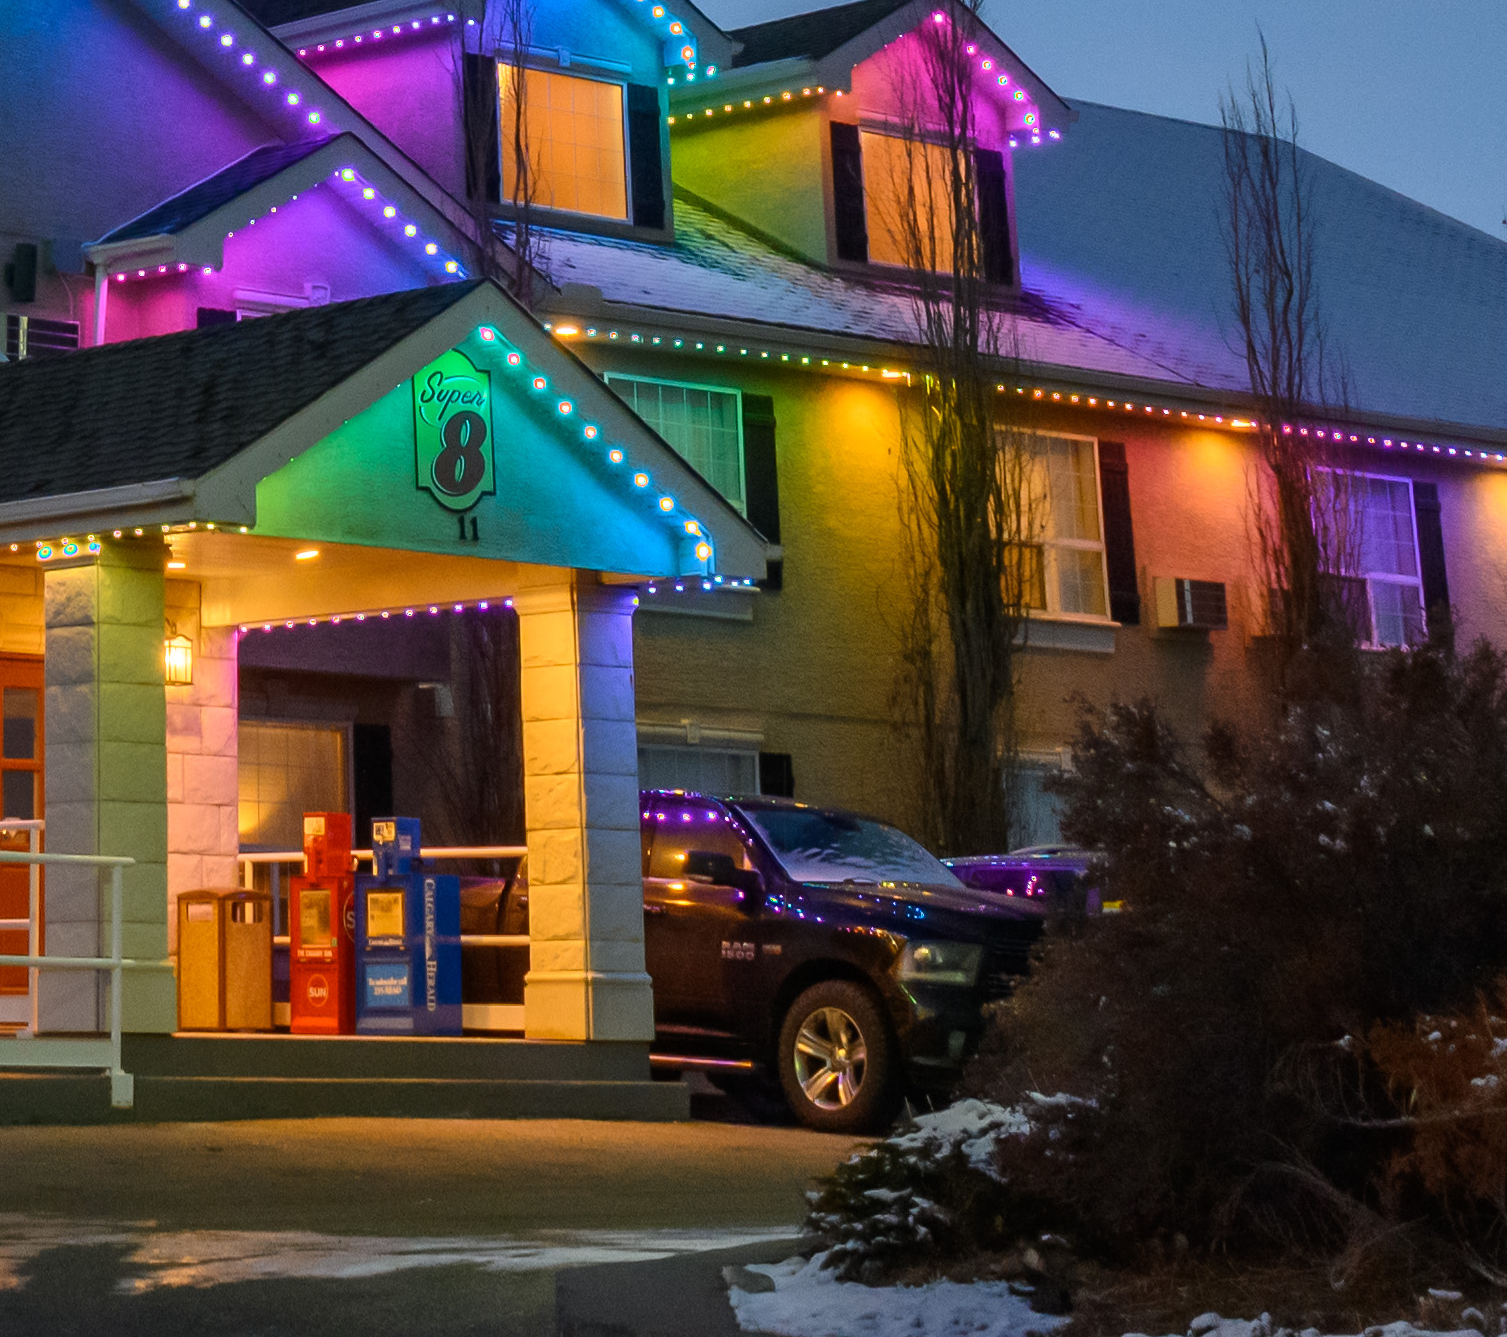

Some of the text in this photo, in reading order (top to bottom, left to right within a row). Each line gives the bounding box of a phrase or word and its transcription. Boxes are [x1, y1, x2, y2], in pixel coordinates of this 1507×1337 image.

[419, 370, 486, 422] Super
[431, 410, 488, 498] 8
[425, 878, 437, 1012] CALGARY HERALD
[309, 987, 327, 998] SUN
